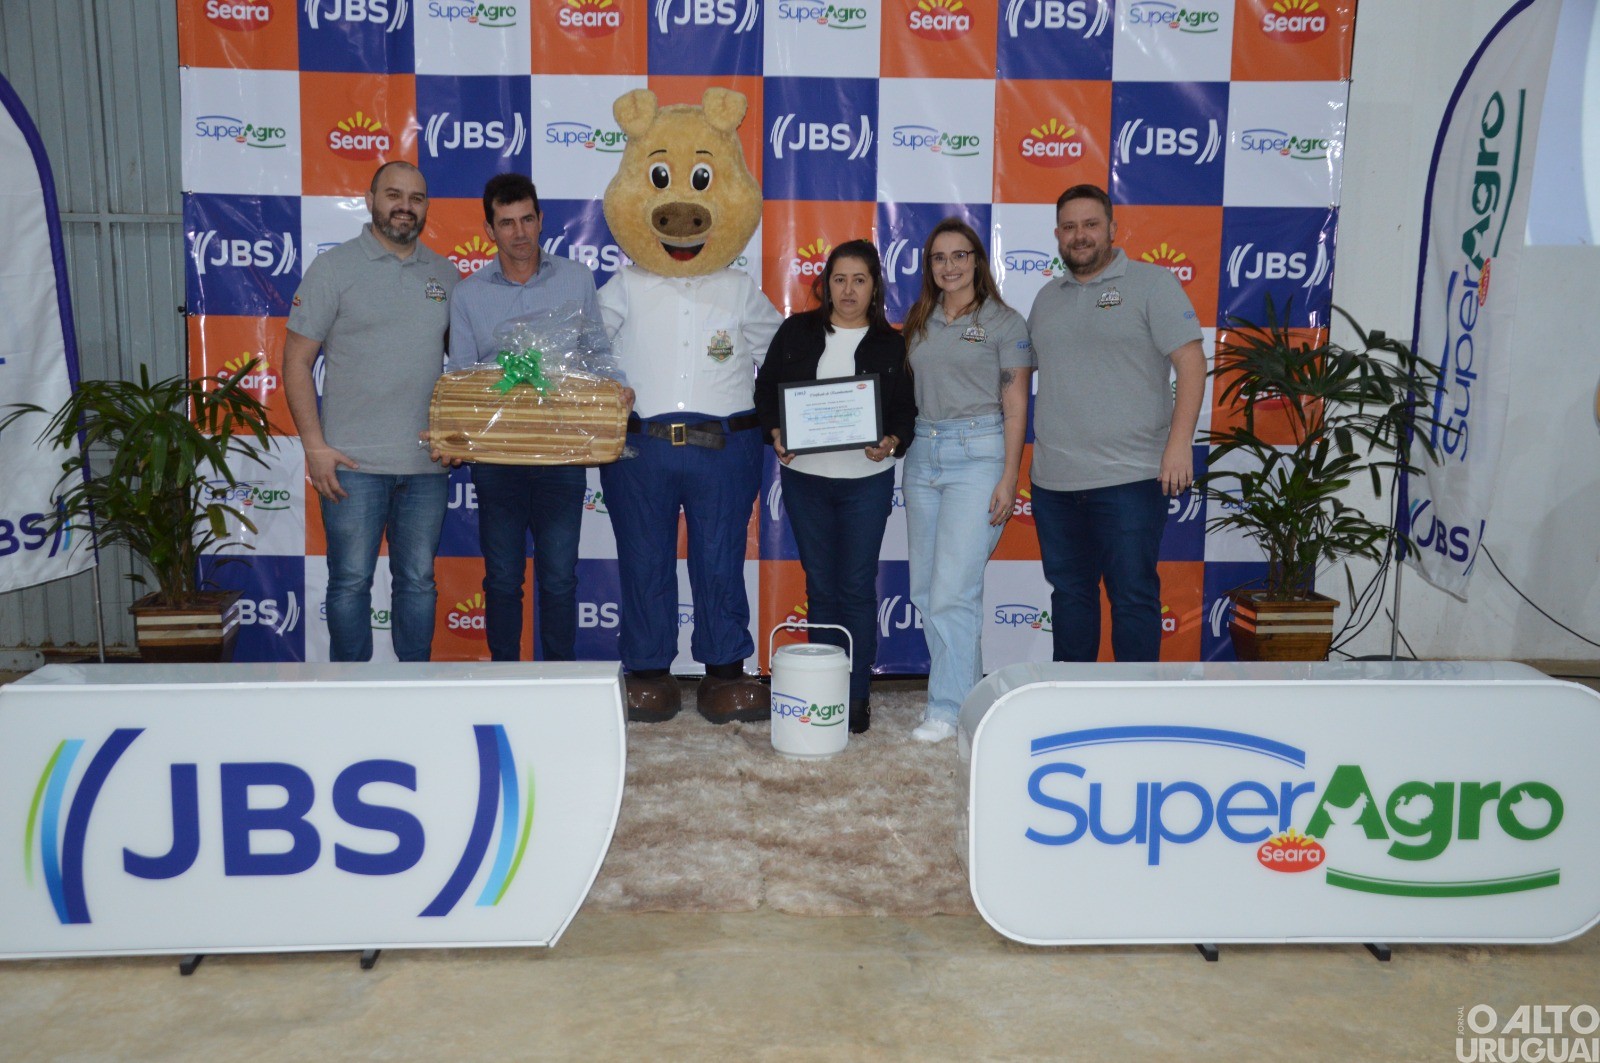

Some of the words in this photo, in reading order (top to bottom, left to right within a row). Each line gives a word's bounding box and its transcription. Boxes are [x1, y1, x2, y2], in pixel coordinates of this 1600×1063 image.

[207, 1, 269, 22] Seara
[325, 0, 389, 23] JBS
[428, 2, 516, 19] SuperAgro
[559, 7, 620, 27] Seara
[674, 0, 737, 25] JBS
[779, 5, 866, 22] SuperAgro
[1024, 0, 1087, 29] JBS
[1130, 9, 1219, 28] SuperAgro
[909, 11, 970, 31] Seara
[1263, 13, 1325, 33] Seara
[196, 122, 286, 142] SuperAgro
[330, 132, 390, 151] Seara
[444, 121, 505, 149] JBS
[789, 123, 851, 150] JBS
[892, 131, 980, 150] SuperAgro
[1136, 128, 1199, 156] JBS
[1022, 138, 1082, 157] Seara
[1241, 135, 1330, 155] SuperAgro
[211, 240, 274, 267] JBS
[789, 258, 827, 276] Sea
[1005, 256, 1067, 275] SuperA
[1245, 252, 1307, 279] JBS
[217, 371, 277, 389] Sara
[204, 485, 291, 504] SperAgro
[447, 482, 479, 509] JB
[0, 512, 48, 557] BS
[1416, 514, 1470, 563] JBS
[238, 598, 279, 626] BS
[448, 612, 487, 630] Sea
[578, 602, 620, 629] BS
[994, 608, 1053, 628] SuperA
[771, 697, 845, 721] SuperAgro
[122, 758, 426, 880] JBS
[1025, 761, 1564, 866] SuperAgro
[1260, 845, 1321, 863] Seara
